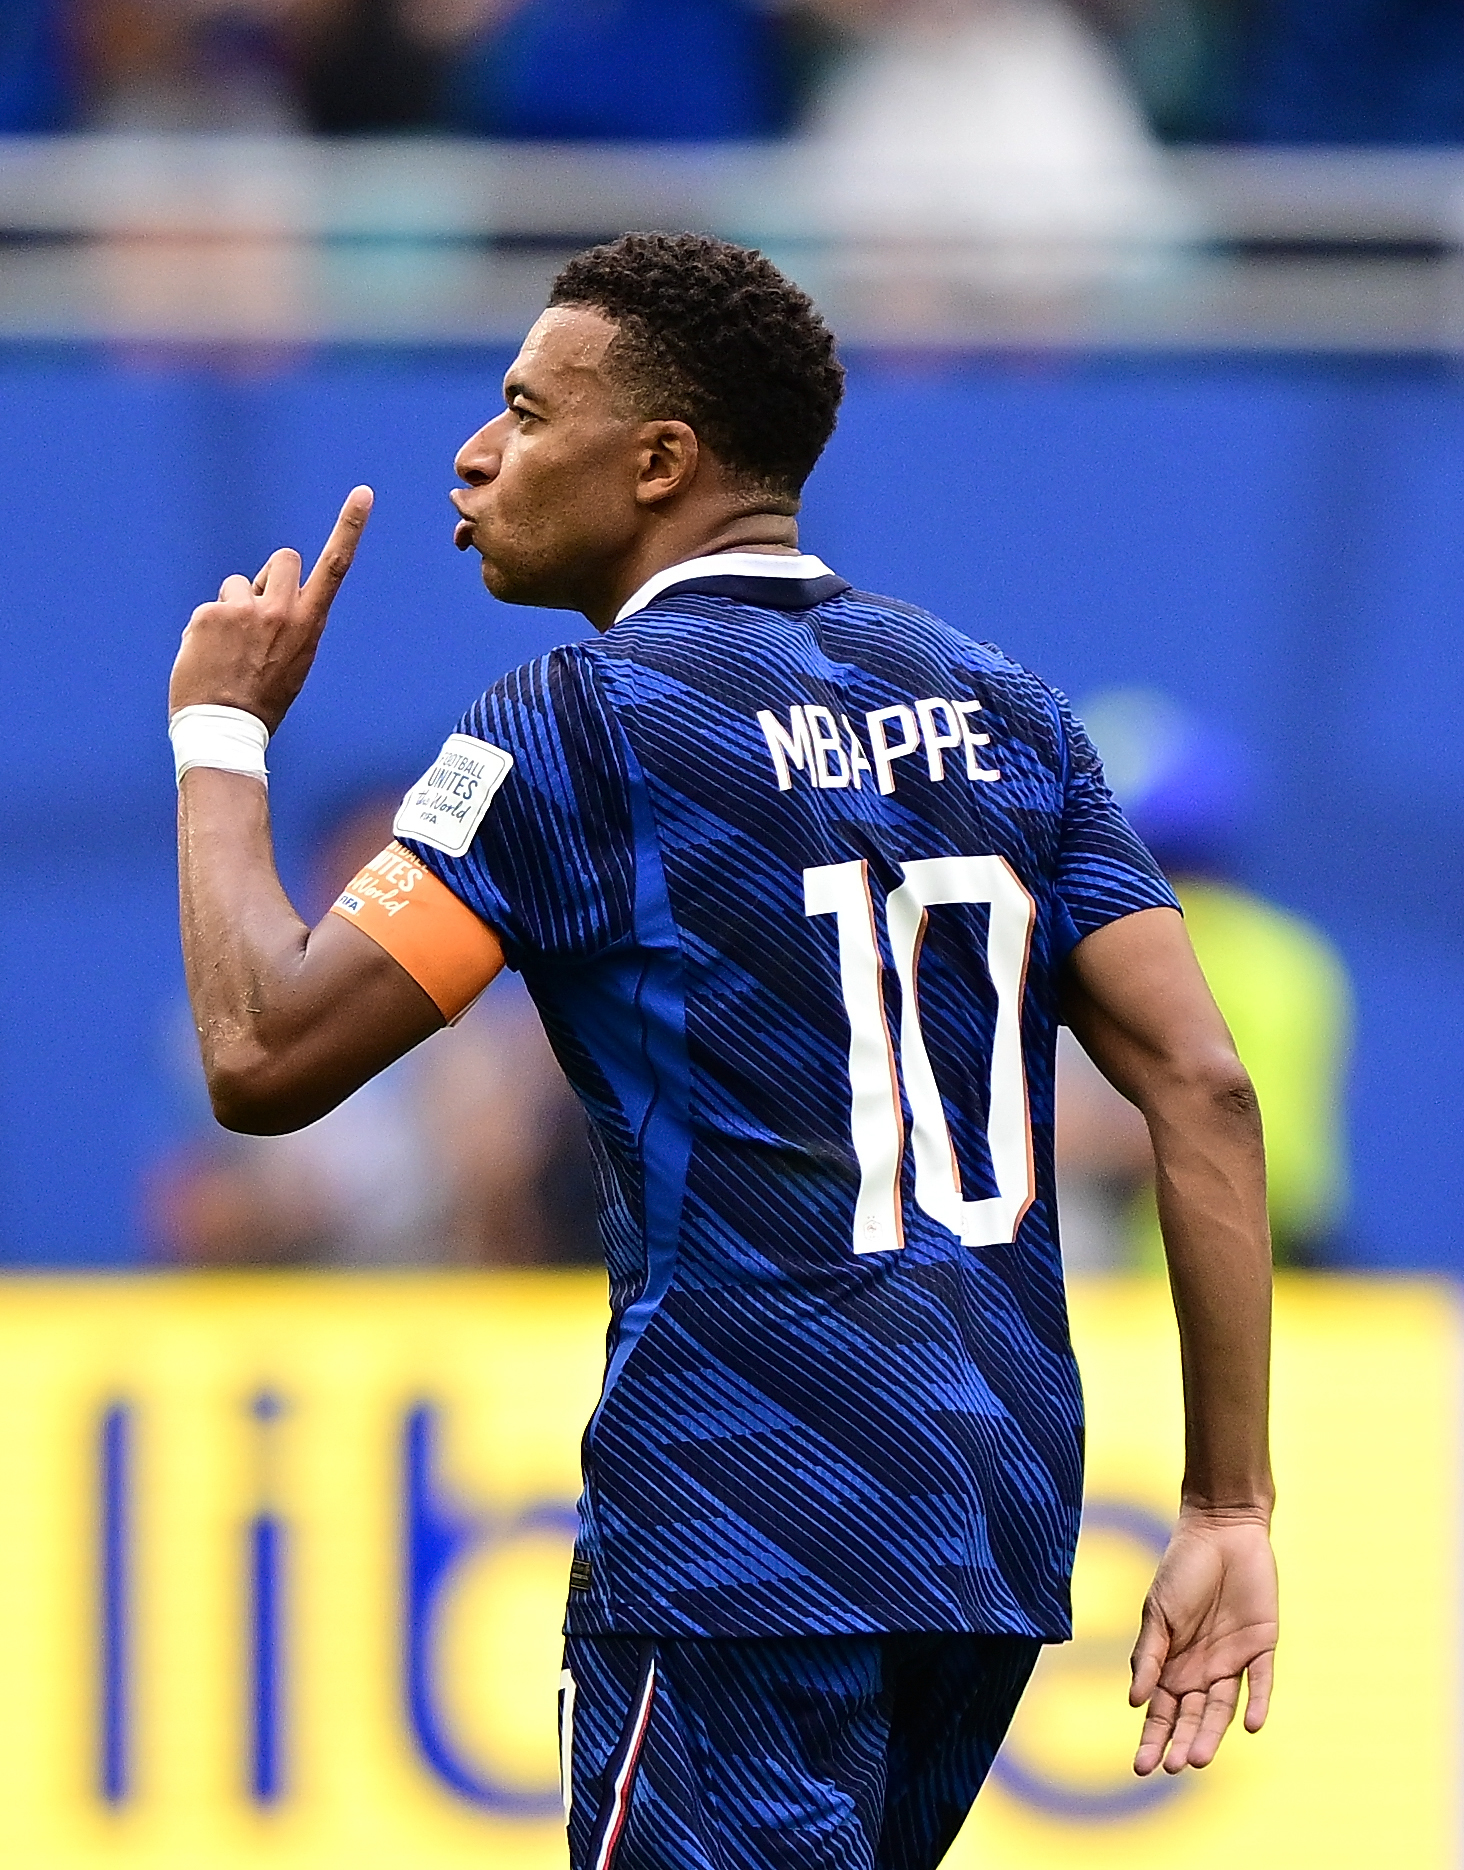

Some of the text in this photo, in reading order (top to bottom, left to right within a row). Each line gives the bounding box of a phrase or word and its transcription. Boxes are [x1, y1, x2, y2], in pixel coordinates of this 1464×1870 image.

[756, 697, 1001, 796] MBAPPE
[439, 752, 485, 780] FOOTBALL
[428, 767, 478, 800] UNITES
[430, 793, 472, 823] World
[804, 855, 1036, 1255] 10
